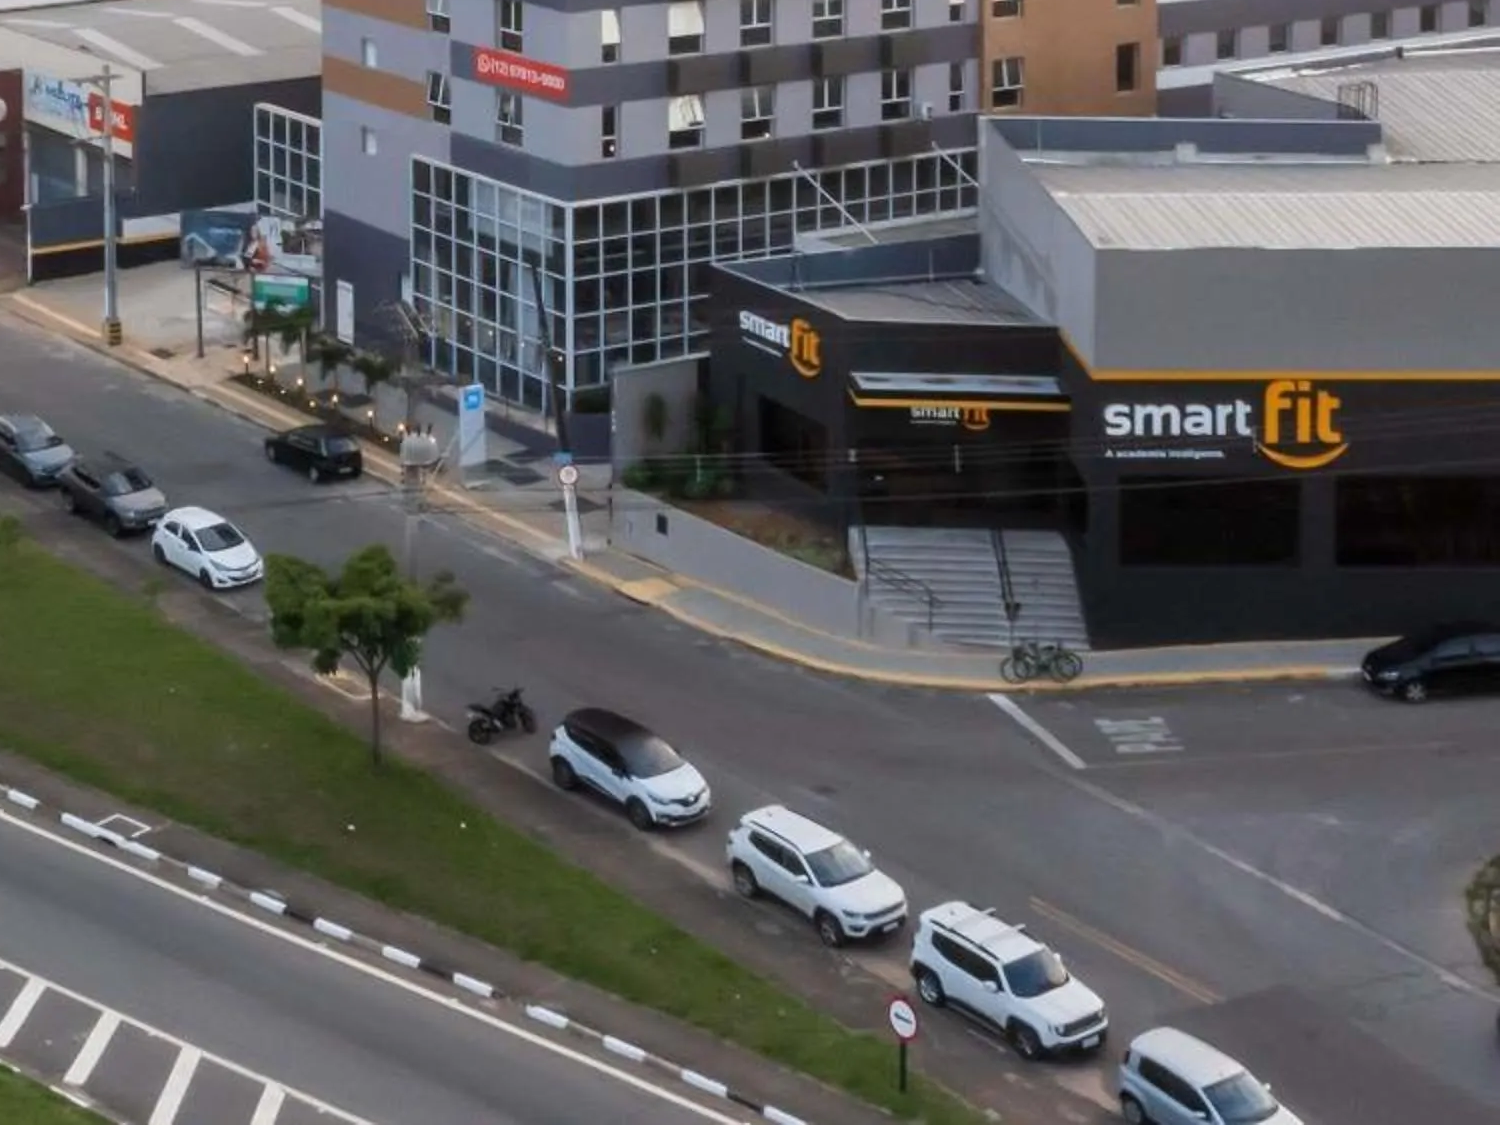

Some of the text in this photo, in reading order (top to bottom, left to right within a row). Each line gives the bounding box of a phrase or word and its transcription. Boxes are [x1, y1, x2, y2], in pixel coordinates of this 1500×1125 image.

[739, 310, 790, 348] smart
[791, 318, 821, 366] fit
[1103, 380, 1342, 444] smart fit
